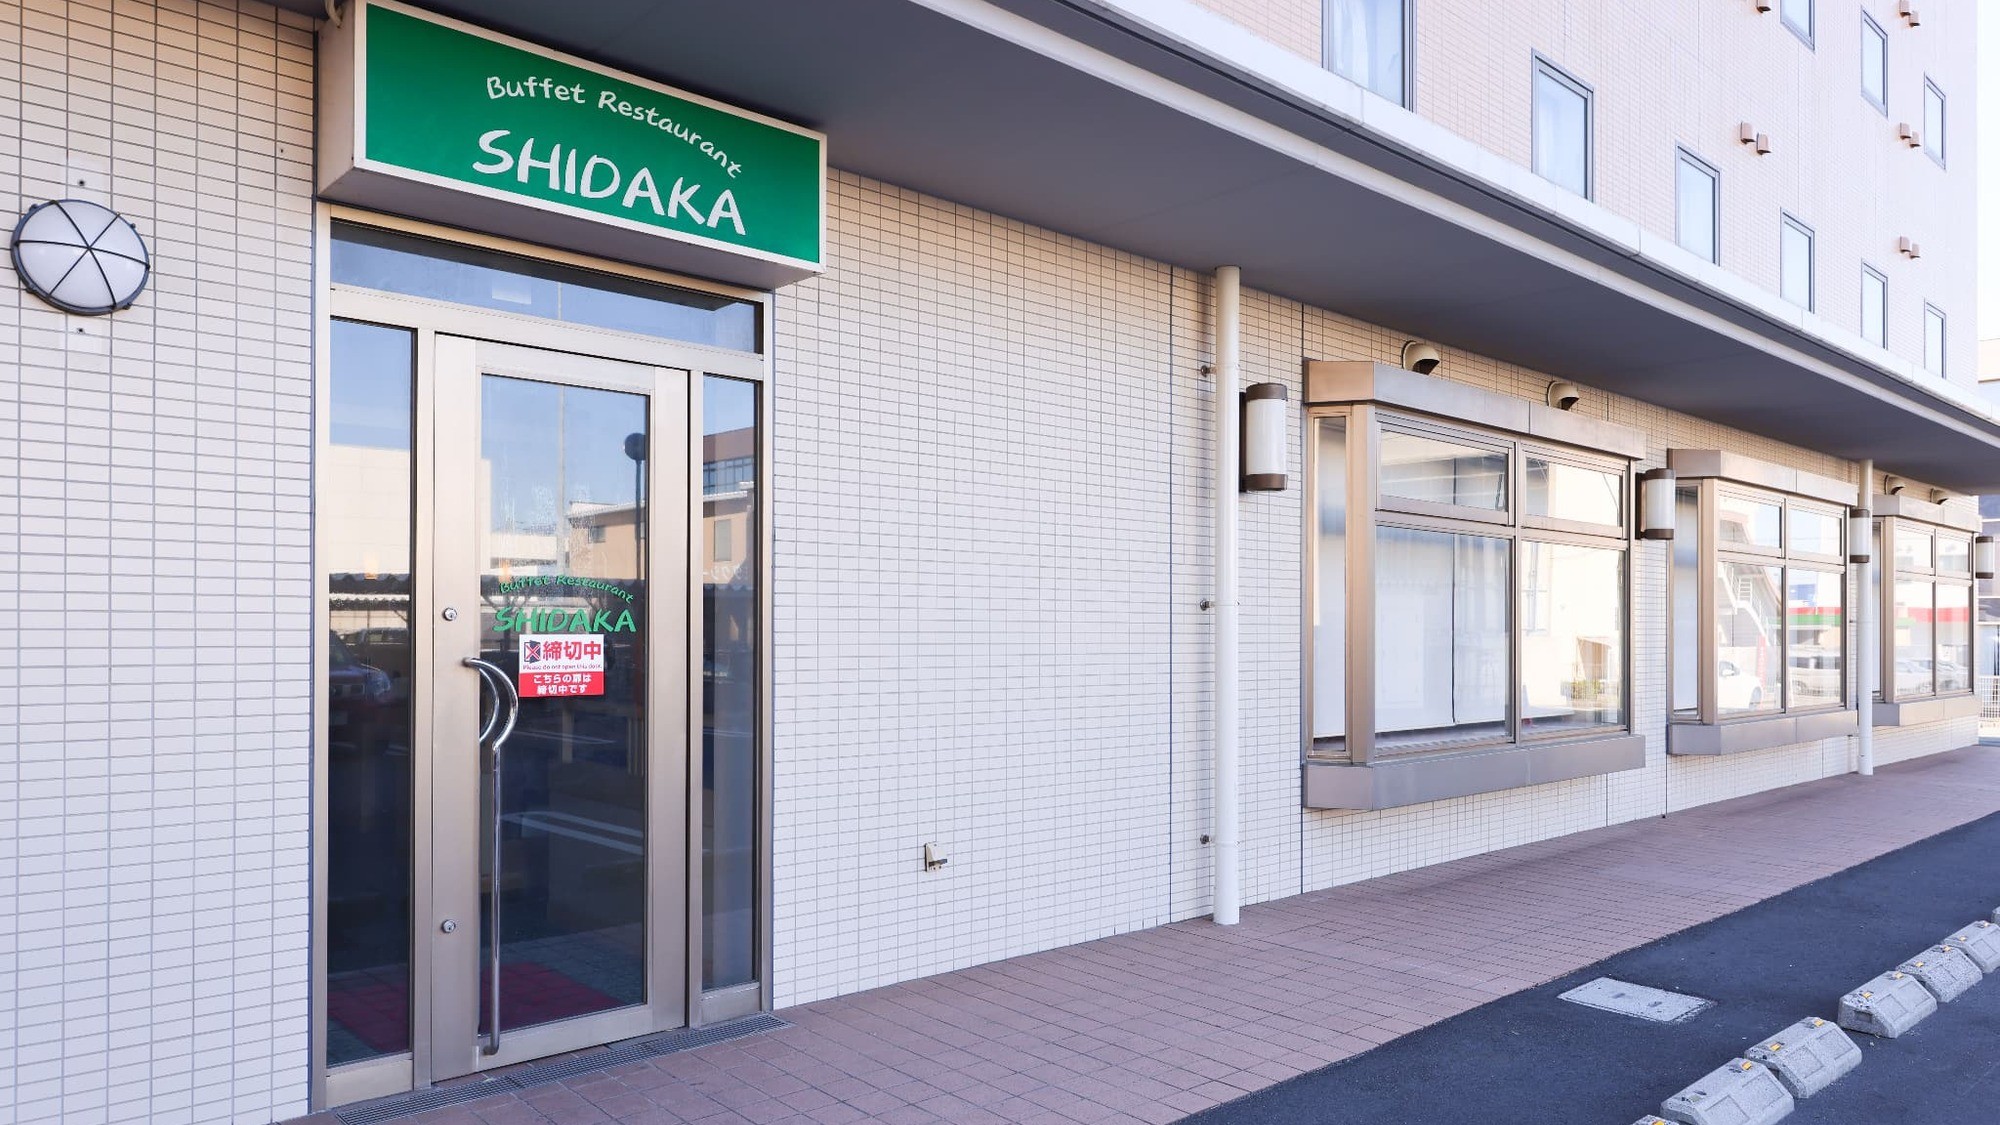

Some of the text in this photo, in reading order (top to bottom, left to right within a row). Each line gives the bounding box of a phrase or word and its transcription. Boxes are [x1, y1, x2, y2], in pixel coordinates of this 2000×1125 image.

[486, 75, 742, 179] Buffet Restaurant
[472, 129, 747, 236] SHIDAKA
[499, 574, 635, 604] Buffet Restaurant
[492, 605, 637, 633] SHIDAKA
[542, 640, 602, 661] 締切中
[536, 684, 588, 695] 締切中です
